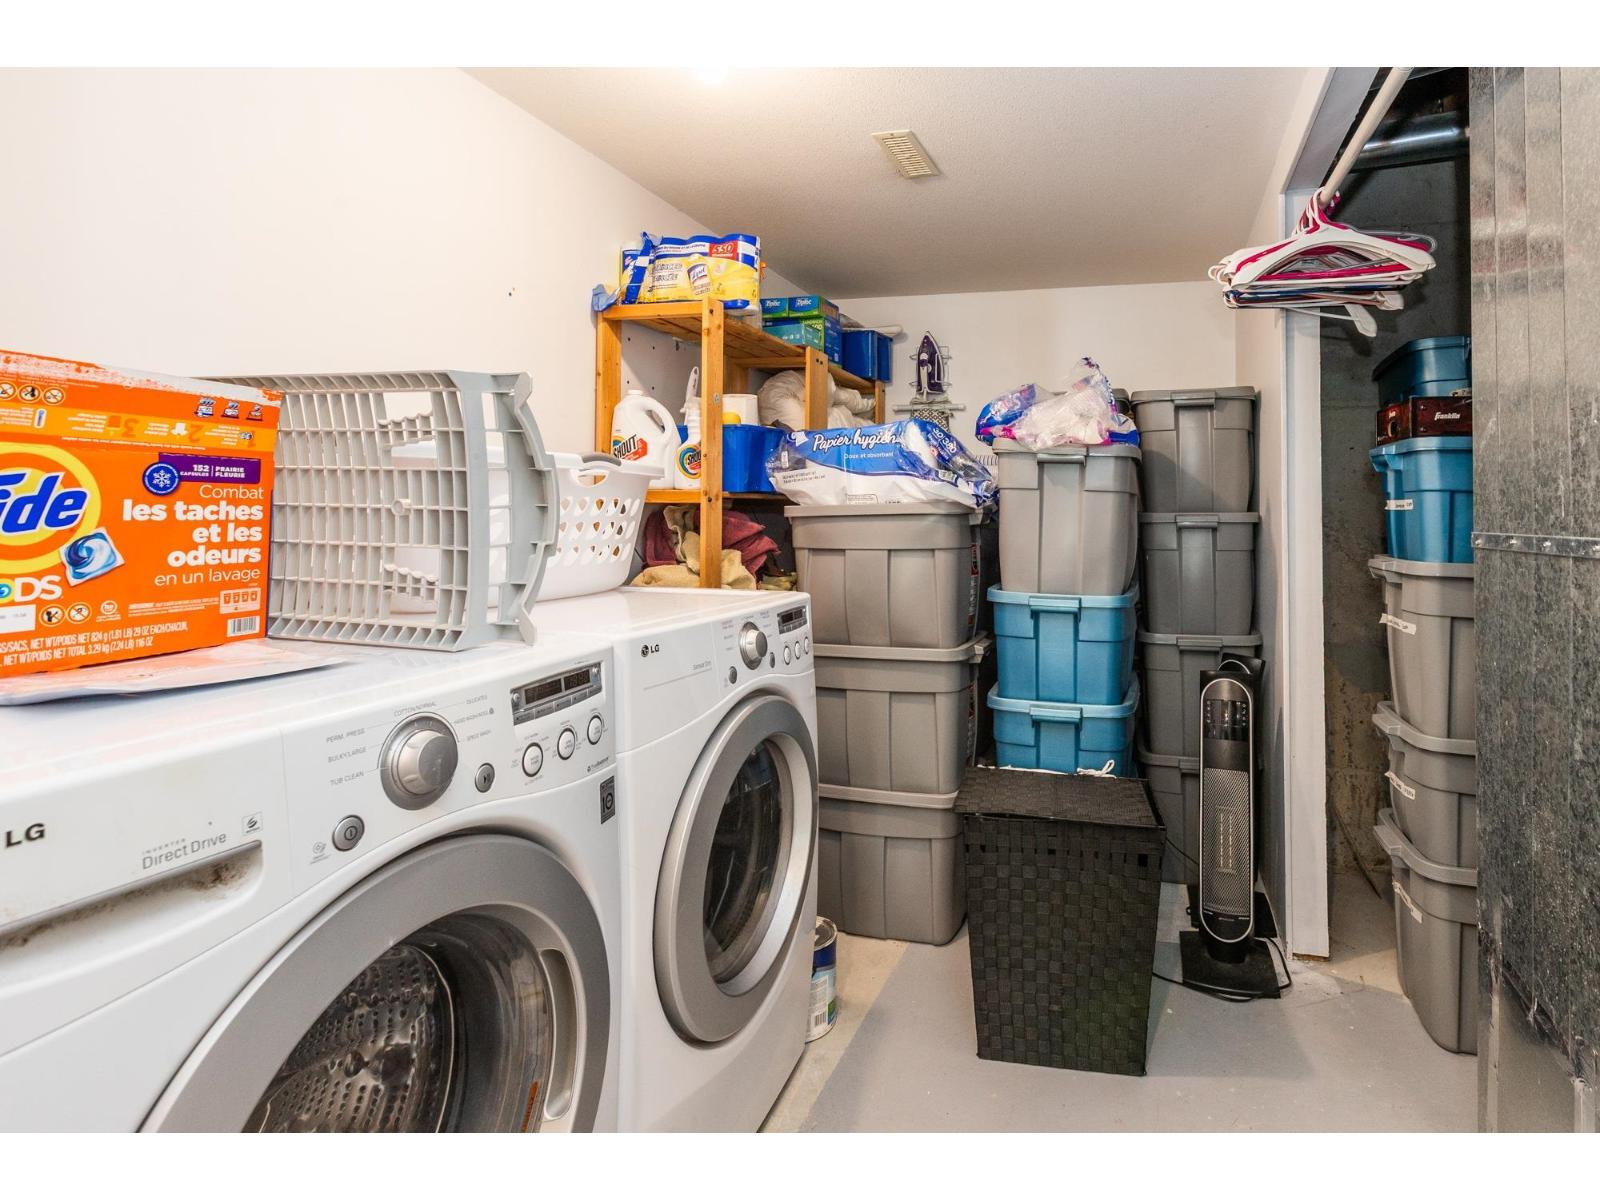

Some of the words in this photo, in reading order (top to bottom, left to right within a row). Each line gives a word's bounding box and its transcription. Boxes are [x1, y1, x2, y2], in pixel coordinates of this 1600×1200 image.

[813, 434, 852, 453] Papier
[200, 484, 264, 499] Combat
[122, 499, 167, 521] les
[174, 500, 263, 520] taches
[192, 523, 221, 543] et
[227, 522, 262, 542] les
[167, 545, 261, 567] odeurs
[154, 573, 177, 586] en
[182, 572, 203, 584] un
[209, 568, 260, 582] lavage
[30, 638, 44, 649] NET
[650, 644, 660, 653] LG
[3, 654, 17, 666] NET
[53, 647, 66, 659] NET
[68, 645, 86, 657] TOTAL
[344, 771, 364, 782] CLEAN
[5, 823, 46, 848] LG
[142, 845, 188, 870] Direct
[191, 833, 227, 853] Drive
